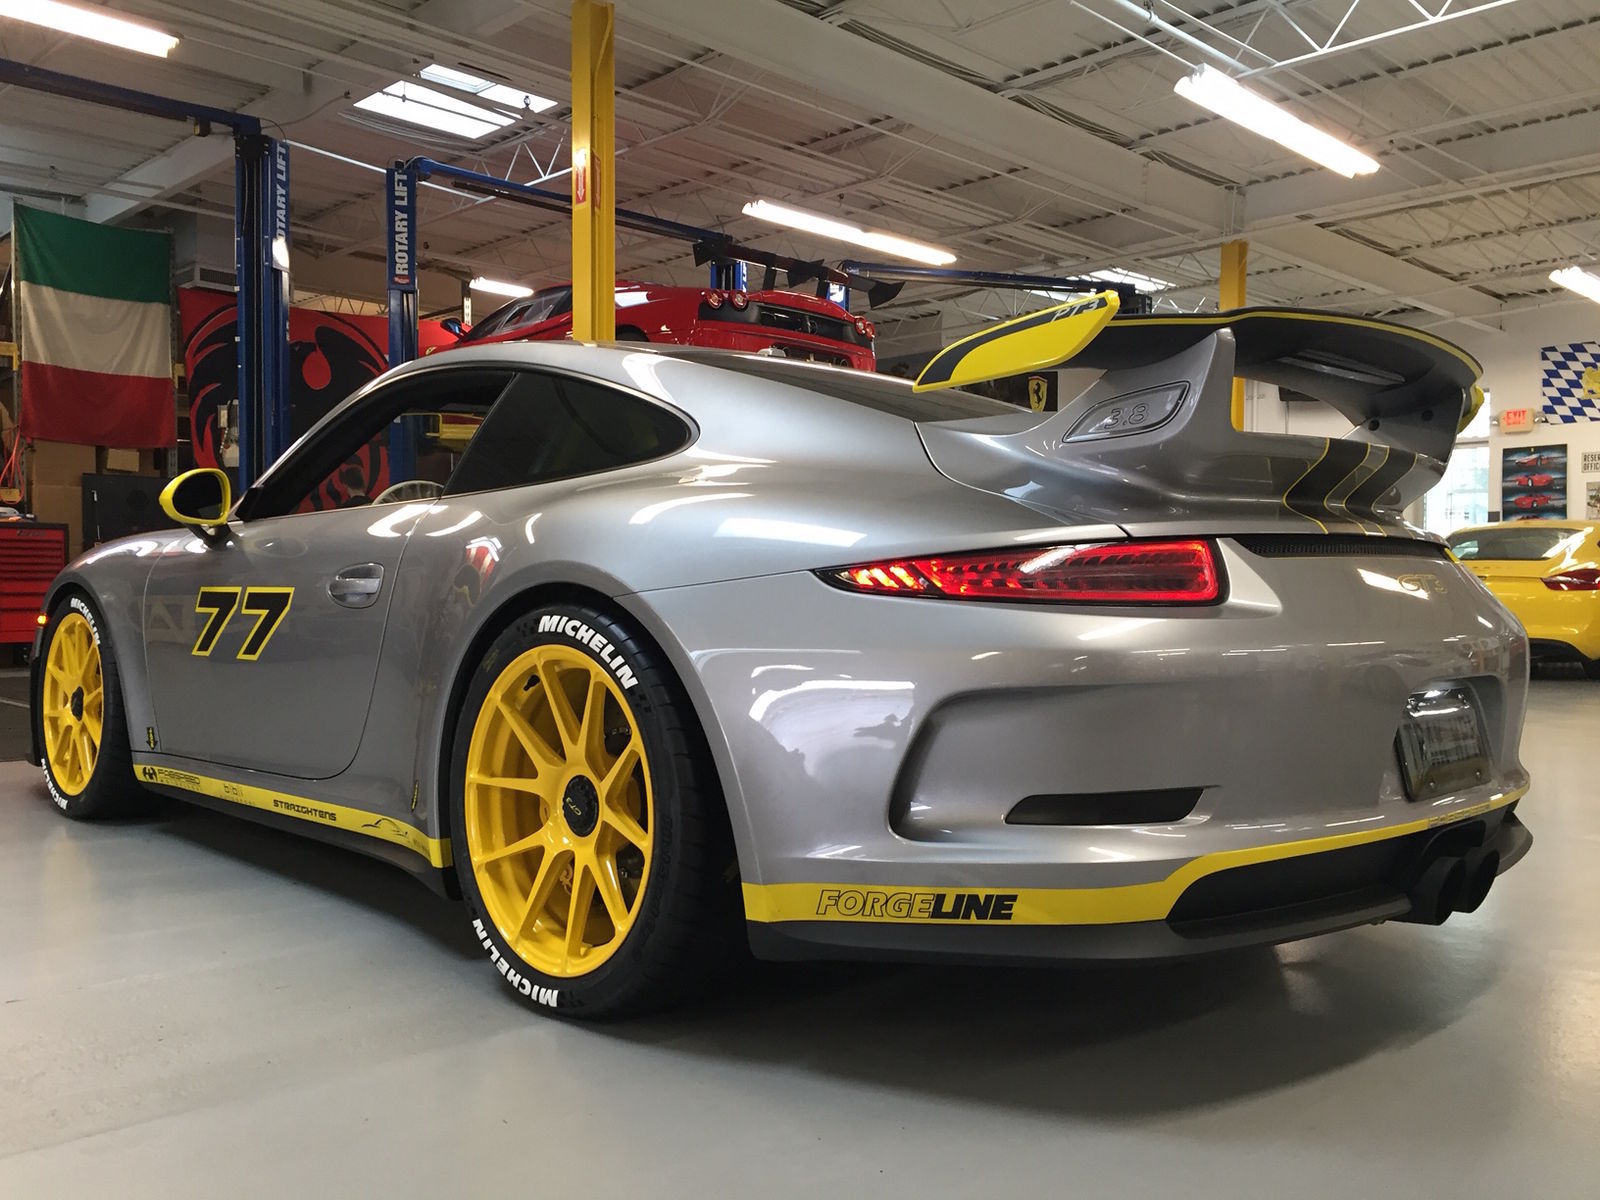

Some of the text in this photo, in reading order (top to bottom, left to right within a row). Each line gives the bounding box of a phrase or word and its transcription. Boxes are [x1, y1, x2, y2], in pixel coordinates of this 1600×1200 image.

[276, 142, 287, 181] LIFT
[394, 172, 409, 275] ROTARY LIFT
[1104, 403, 1149, 429] 3.8
[1506, 409, 1527, 426] EXIT
[70, 597, 101, 646] MICHELIN
[191, 586, 295, 661] 77
[538, 614, 639, 690] MICHELIN
[41, 758, 69, 810] MICHELIN
[816, 889, 1019, 921] FORGELINE
[472, 918, 559, 1008] MICHELIN
